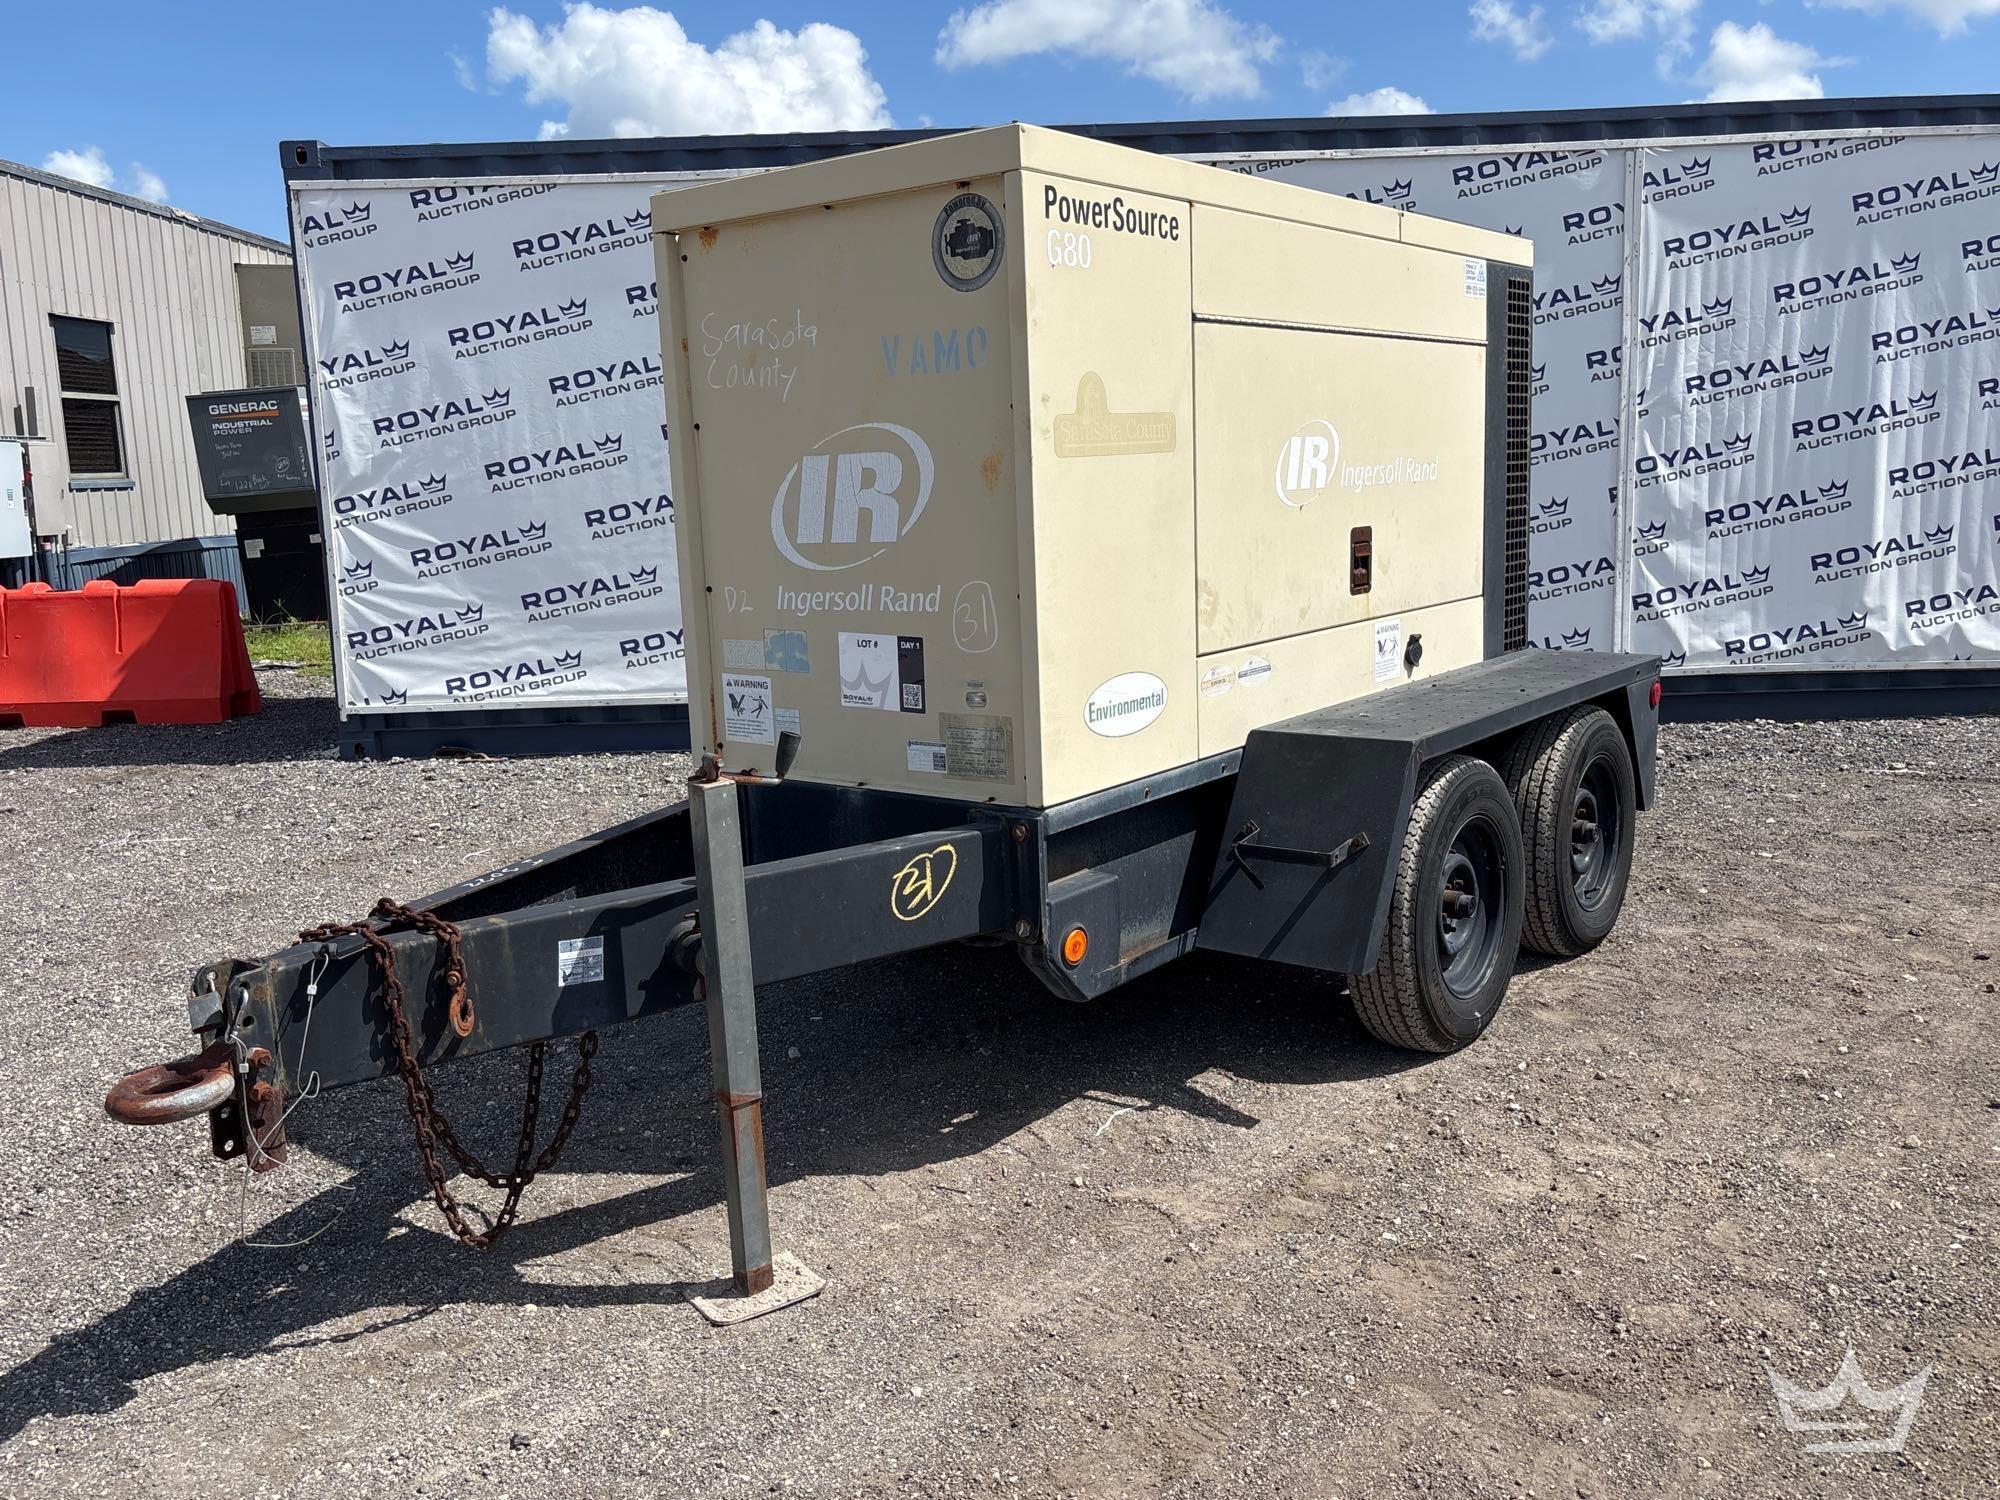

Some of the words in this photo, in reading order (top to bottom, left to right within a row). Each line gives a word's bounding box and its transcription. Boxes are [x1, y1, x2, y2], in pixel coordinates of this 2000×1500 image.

[1757, 151, 1839, 177] AUCTION
[1842, 137, 1905, 157] GROUP
[1458, 175, 1535, 200] AUCTION
[1539, 157, 1602, 181] GROUP
[1652, 179, 1715, 203] GROUP
[1852, 171, 1970, 212] ROYAL
[417, 198, 493, 223] AUCTION
[498, 184, 557, 203] GROUP
[1044, 185, 1179, 241] PowerSource
[1856, 200, 1938, 226] AUCTION
[319, 224, 377, 246] GROUP
[513, 218, 624, 258] ROYAL
[1048, 230, 1091, 269] G80
[1568, 223, 1625, 245] AUCTI
[1663, 217, 1781, 257] ROYAL
[1668, 243, 1748, 271] AUCTION
[1751, 228, 1814, 251] GROUP
[520, 246, 594, 272] AUCTION
[333, 262, 447, 301] ROYAL
[342, 289, 417, 314] AUCTION
[421, 274, 480, 296] GROUP
[1533, 285, 1591, 310] YAL
[1773, 262, 1891, 302] ROYAL
[1778, 290, 1858, 316] AUCTION
[1861, 275, 1923, 297] GROUP
[447, 307, 560, 347] ROYAL
[1639, 306, 1702, 332] YAL
[1675, 319, 1736, 341] GROUP
[1872, 312, 1988, 351] ROYAL
[455, 334, 530, 360] AUCTION
[534, 320, 593, 342] GROUP
[1876, 340, 1954, 364] AUCTION
[319, 349, 383, 375] YAL
[357, 361, 415, 383] GROUP
[548, 356, 660, 394] ROYAL
[707, 359, 800, 401] County
[1685, 354, 1800, 394] ROYAL
[556, 383, 631, 407] AUCTION
[635, 375, 663, 392] GRO
[1689, 381, 1767, 407] AUCTION
[1770, 366, 1833, 388] GROUP
[209, 400, 277, 415] GENERAC
[212, 420, 273, 429] INDUSTRIAL
[373, 397, 483, 435] ROYAL
[1792, 399, 1909, 438] ROYAL
[214, 427, 252, 435] POWER
[380, 424, 454, 448] AUCTION
[457, 409, 516, 432] GROUP
[1530, 420, 1614, 452] OYAL
[1796, 428, 1878, 452] AUCTION
[1880, 411, 1940, 433] GROUP
[484, 442, 595, 480] ROYAL
[491, 469, 565, 493] AUCTION
[569, 454, 628, 475] GROUP
[1286, 436, 1329, 490] IR
[1340, 457, 1402, 493] Ingersoll
[1405, 455, 1439, 483] Rand
[1530, 447, 1582, 466] CTION
[1635, 442, 1723, 474] OYAL
[1695, 453, 1755, 475] GROUP
[334, 483, 420, 514] OYAL
[395, 494, 452, 515] GROUP
[797, 452, 902, 545] IR
[1892, 475, 1971, 499] AUCTION
[584, 494, 674, 527] ROYA
[1705, 489, 1819, 528] ROYAL
[1708, 515, 1785, 540] AUCTION
[1789, 501, 1852, 524] GROUP
[591, 516, 665, 540] AUCTION
[411, 529, 520, 567] ROYAL
[417, 555, 491, 579] AUCTION
[494, 541, 552, 562] GROUP
[1634, 541, 1669, 557] OUP
[1810, 533, 1924, 571] ROYAL
[1815, 560, 1893, 584] AUCTION
[1895, 545, 1956, 567] GROUP
[1529, 557, 1614, 588] ROYA
[1529, 580, 1603, 601] AUCTION
[520, 574, 630, 610] ROYAL
[527, 600, 602, 623] AUCTION
[605, 586, 663, 607] GROUP
[776, 584, 873, 616] Ingersoll
[880, 584, 941, 614] Rand
[1632, 573, 1741, 611] ROYAL
[1635, 598, 1711, 623] AUCTION
[1714, 585, 1773, 606] GROUP
[1905, 584, 2000, 618] ROYA
[347, 612, 457, 649] ROYAL
[1910, 606, 1987, 631] AUCTION
[354, 638, 427, 661] AUCTION
[431, 624, 489, 645] GROUP
[619, 628, 683, 657] ROY
[857, 640, 872, 648] LOT
[1724, 621, 1838, 657] ROYAL
[1809, 632, 1871, 652] GROUP
[626, 648, 685, 669] AUCTIO
[446, 659, 555, 695] ROYAL
[529, 670, 587, 691] GROUP
[733, 680, 768, 689] WARNING
[1089, 688, 1164, 723] Environmental
